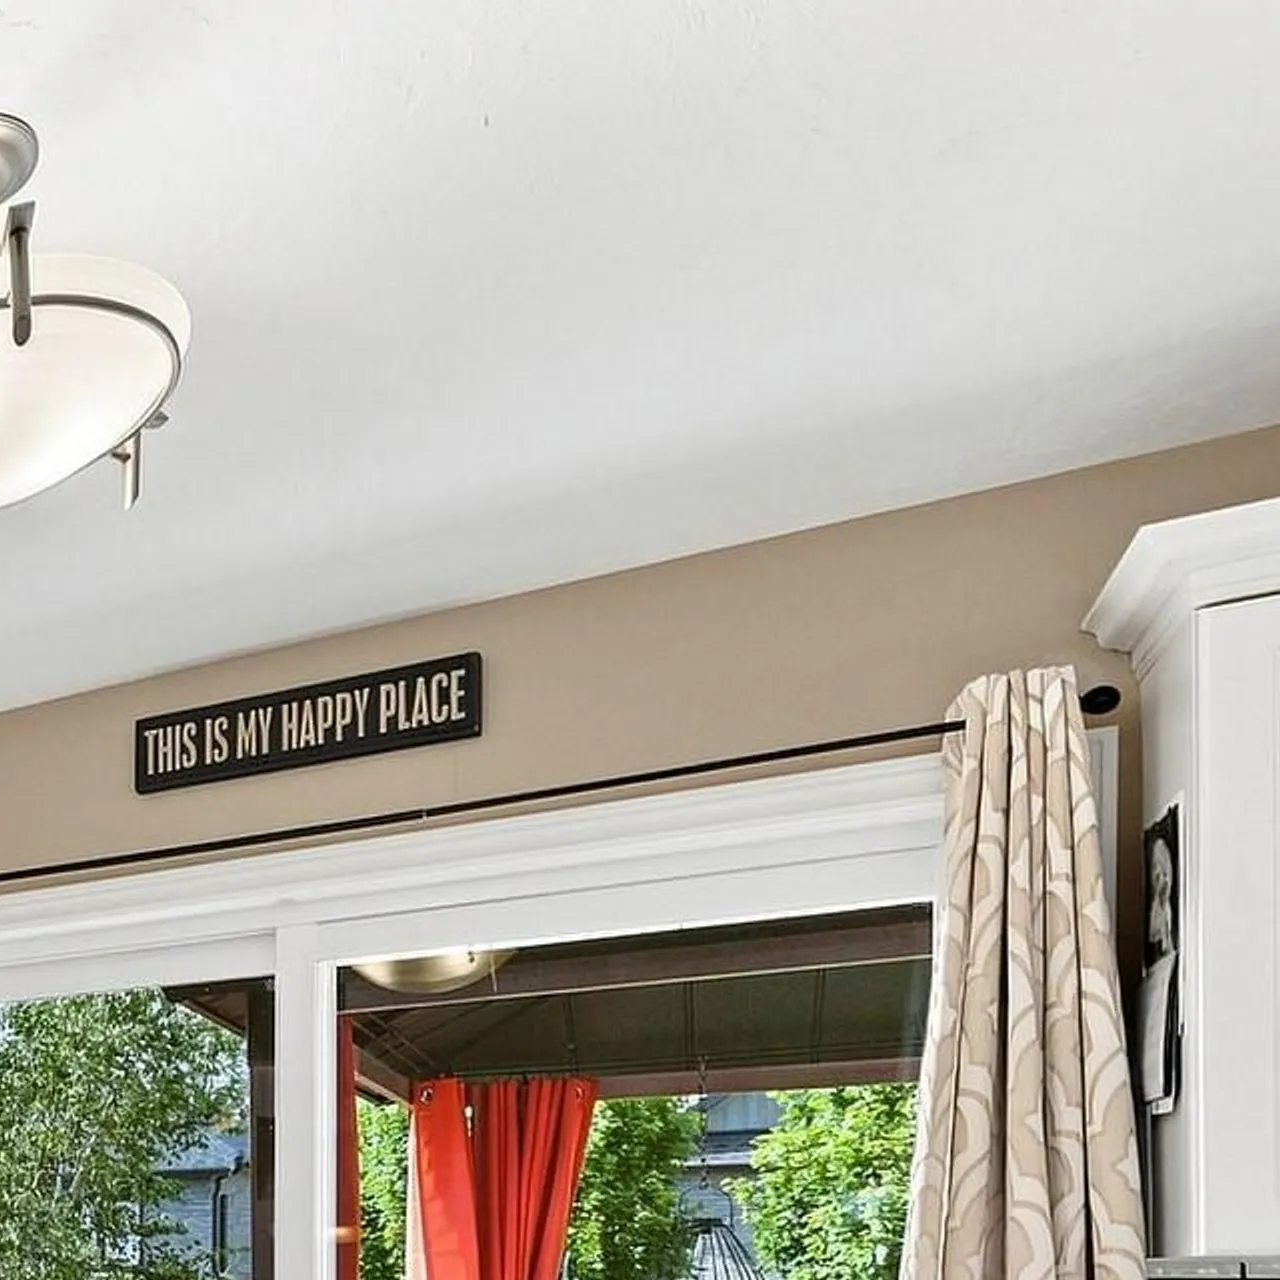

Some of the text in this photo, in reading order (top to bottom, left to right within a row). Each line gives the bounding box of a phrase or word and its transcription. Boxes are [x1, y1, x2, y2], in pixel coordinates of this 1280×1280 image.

[143, 668, 467, 776] THIS IS MY HAPPY PLACE
